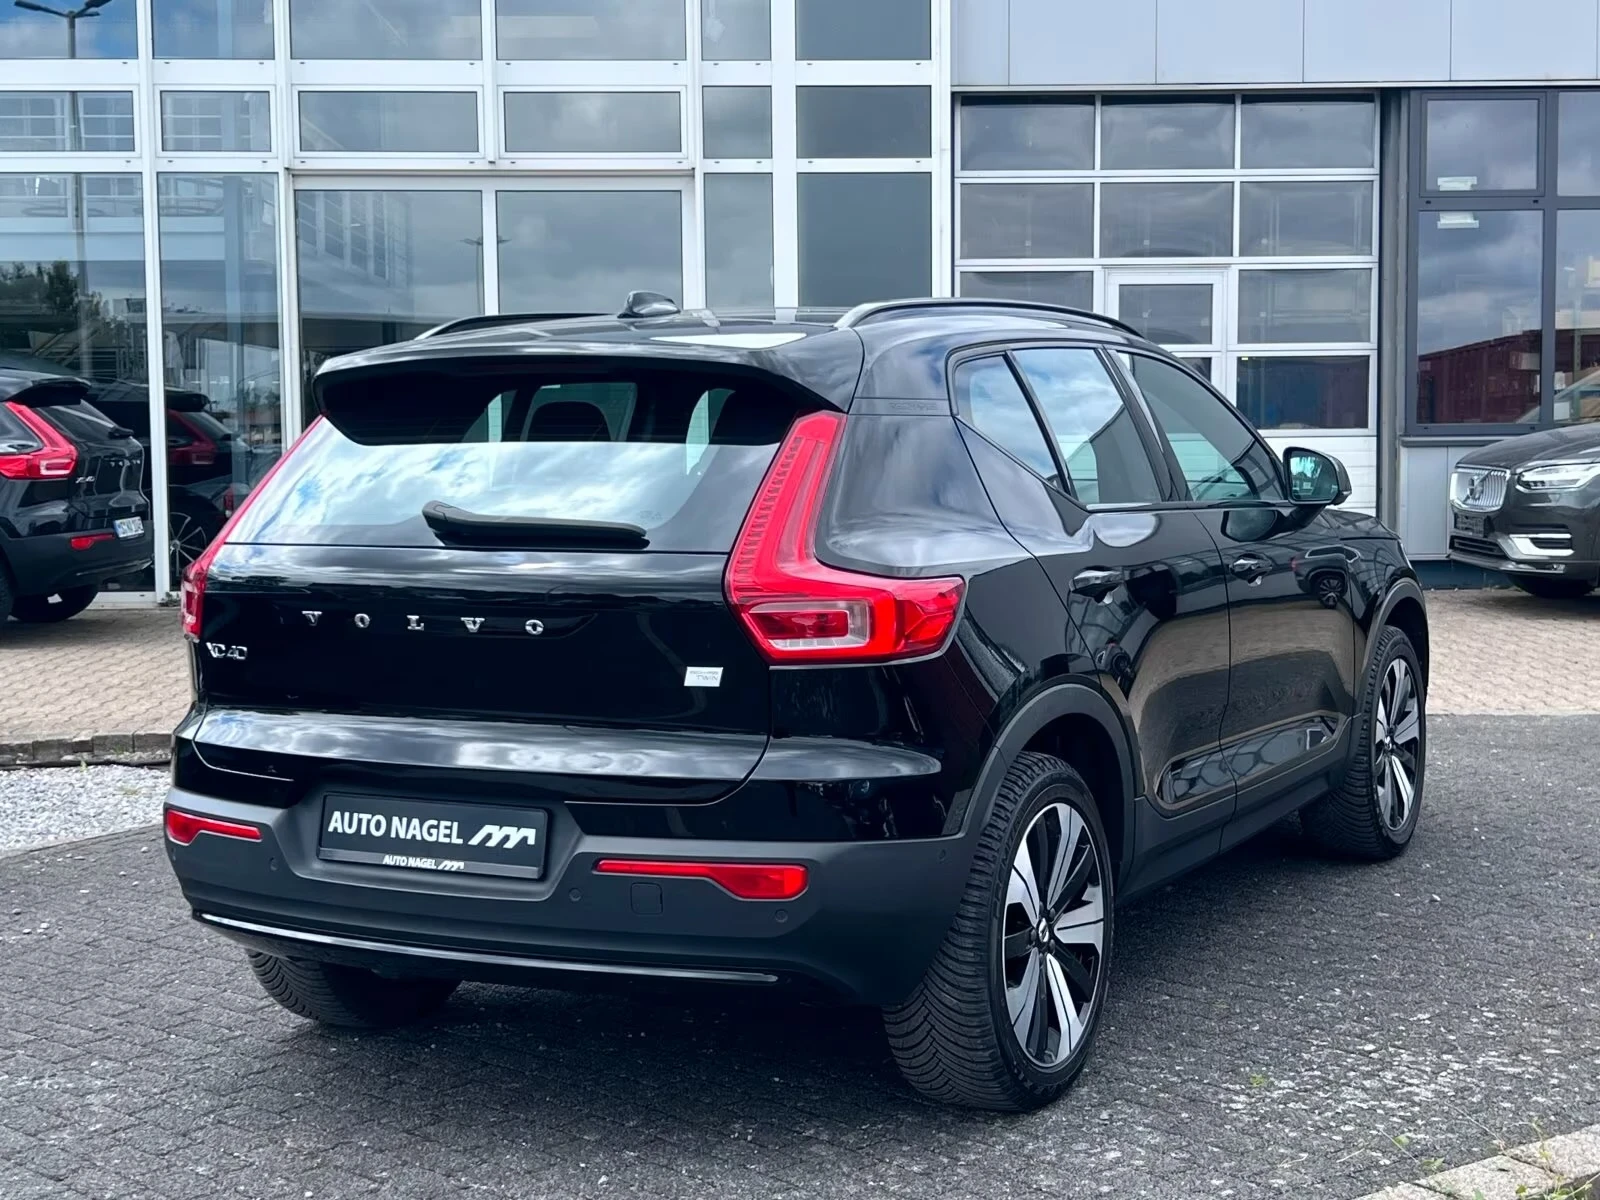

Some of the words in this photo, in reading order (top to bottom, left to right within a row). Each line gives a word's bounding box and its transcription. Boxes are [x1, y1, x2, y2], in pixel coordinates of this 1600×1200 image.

[302, 611, 545, 636] VOLVO
[328, 811, 387, 837] AUTO
[390, 816, 463, 844] NAGEL
[383, 855, 407, 867] AUTO
[407, 857, 437, 870] NAGEL
